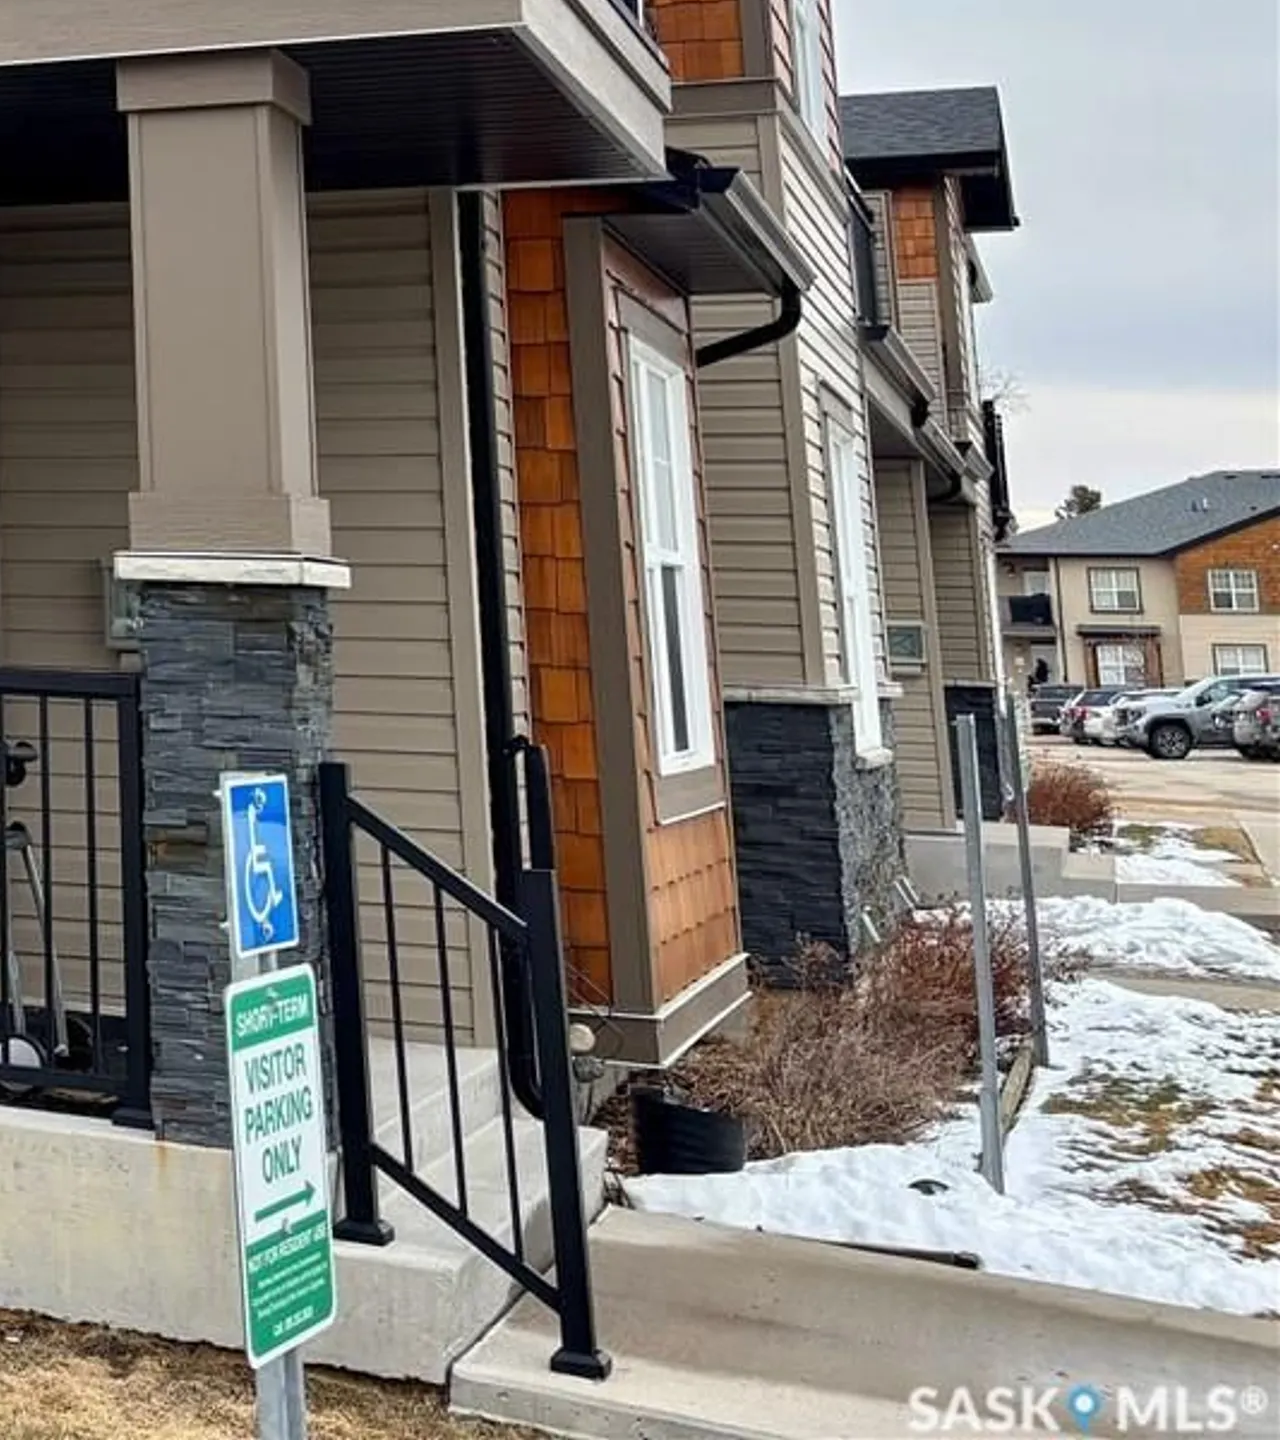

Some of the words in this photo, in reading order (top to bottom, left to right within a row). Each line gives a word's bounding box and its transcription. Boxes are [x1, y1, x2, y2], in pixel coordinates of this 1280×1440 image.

[235, 992, 309, 1038] SHORT-TERM
[244, 1042, 307, 1094] VISITOR
[244, 1085, 313, 1144] PARKING
[261, 1134, 302, 1184] ONLY
